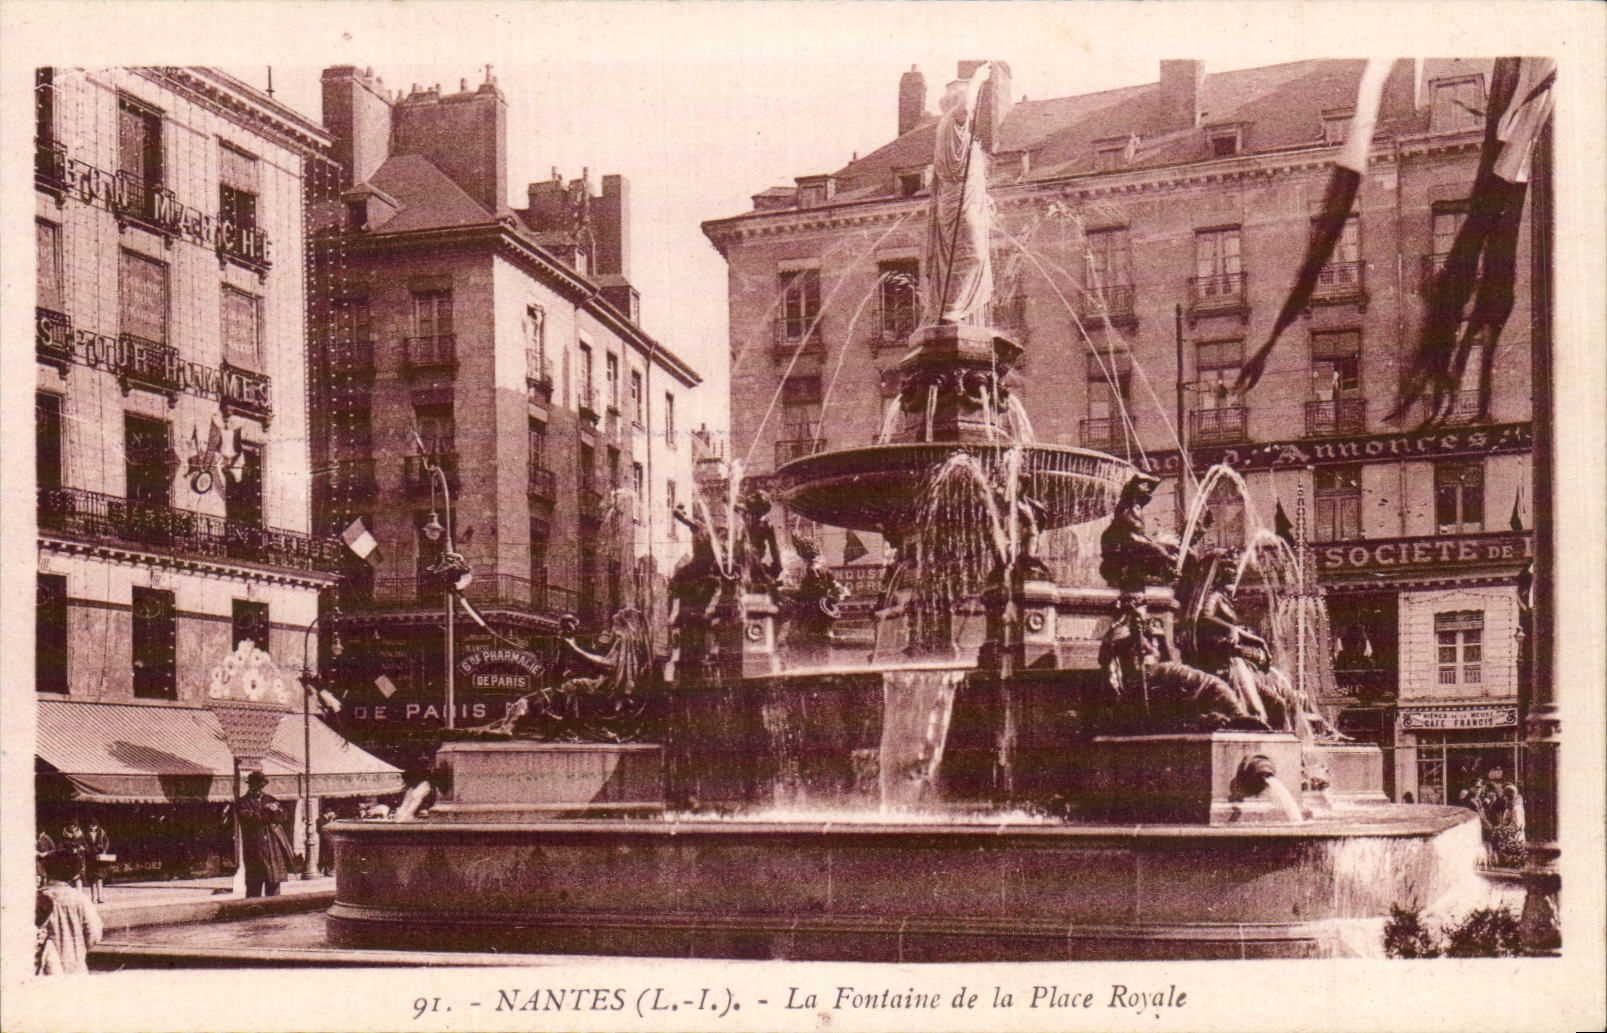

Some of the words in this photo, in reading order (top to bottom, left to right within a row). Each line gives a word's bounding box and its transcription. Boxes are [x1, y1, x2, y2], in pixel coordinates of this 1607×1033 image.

[73, 327, 151, 374] POUR
[164, 352, 273, 409] HOMMES
[482, 650, 542, 675] PHARMACIE
[476, 676, 490, 686] DE
[491, 676, 527, 687] PARIS
[354, 705, 388, 720] DE
[1454, 719, 1493, 727] FRANCIS
